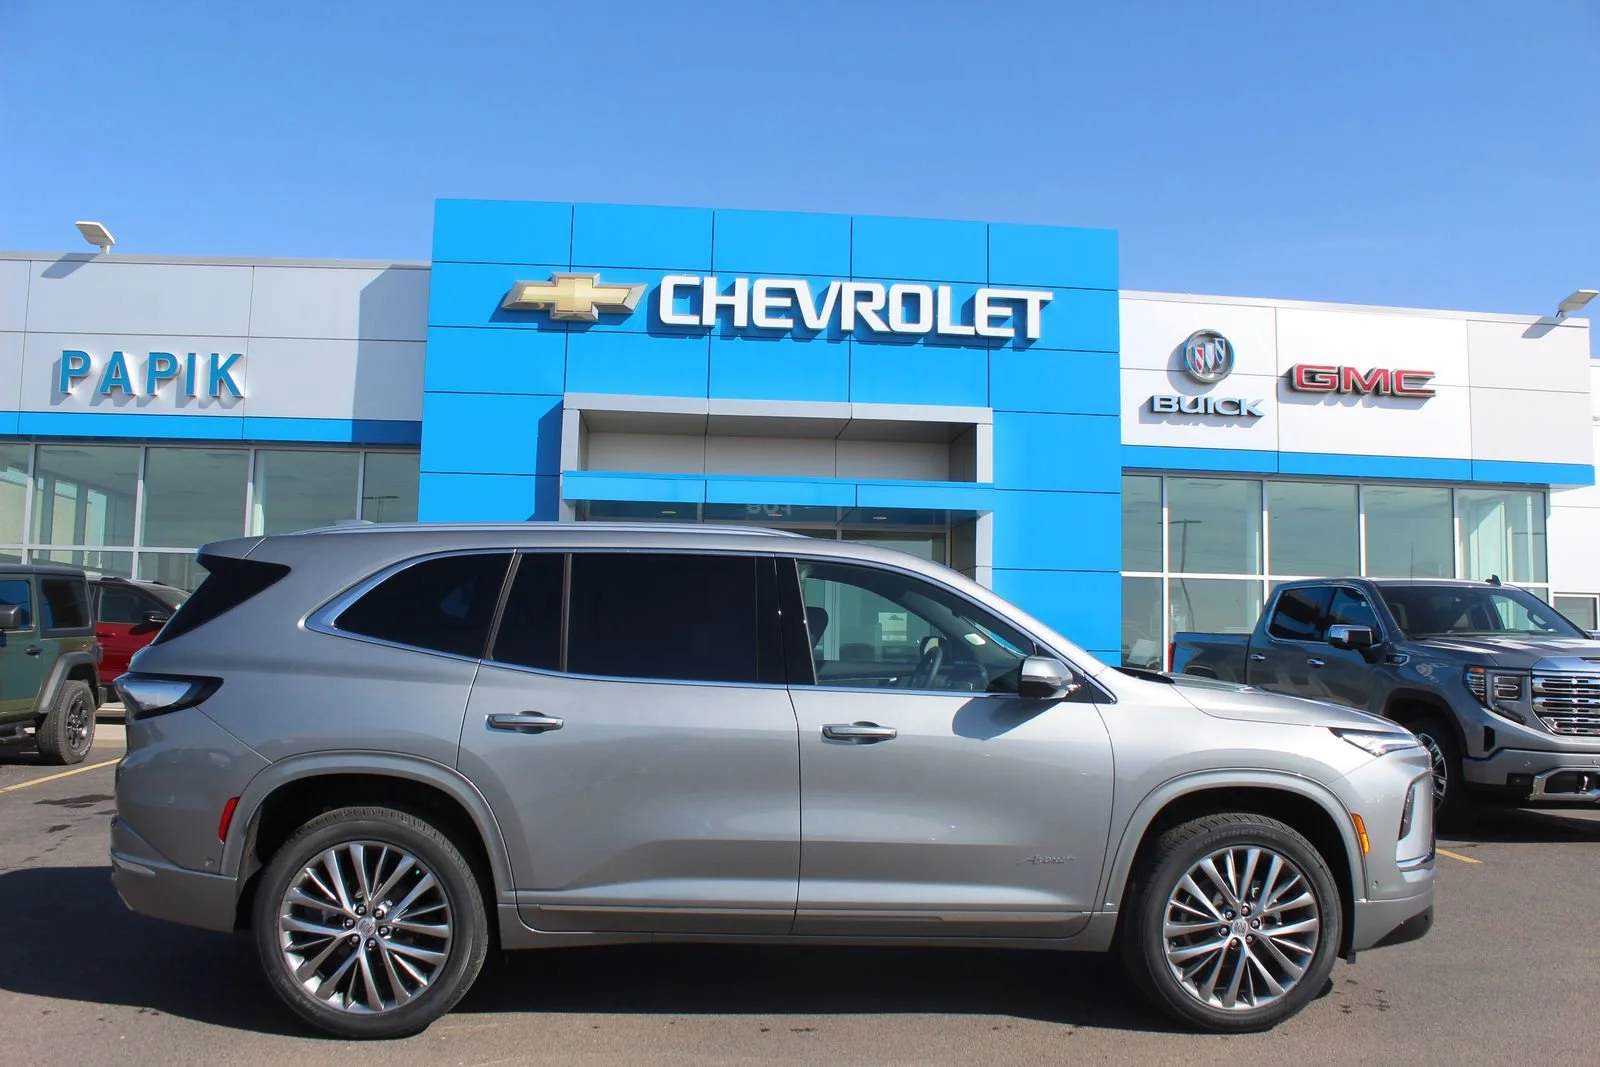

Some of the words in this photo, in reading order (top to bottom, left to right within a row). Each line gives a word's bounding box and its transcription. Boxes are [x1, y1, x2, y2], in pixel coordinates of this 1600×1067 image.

[660, 275, 1054, 340] CHEVROLET
[60, 350, 245, 398] PAPIK
[1290, 363, 1436, 398] GMC
[1151, 394, 1265, 417] BUICK
